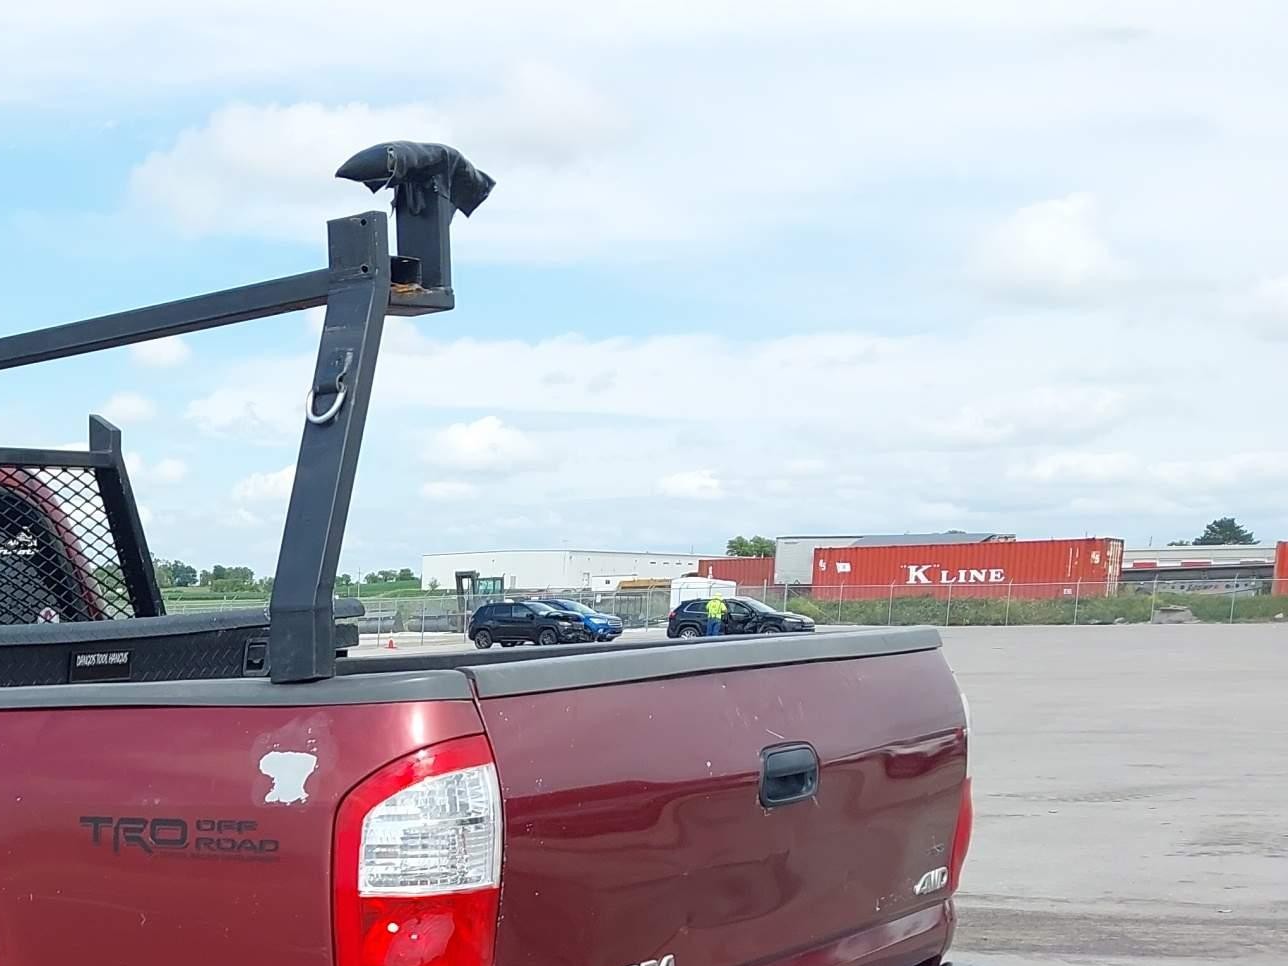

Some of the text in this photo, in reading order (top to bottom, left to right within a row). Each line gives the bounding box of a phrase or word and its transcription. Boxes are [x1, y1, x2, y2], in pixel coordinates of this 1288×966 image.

[940, 569, 1005, 583] LINE
[196, 819, 258, 834] OFF
[195, 837, 279, 852] ROAD
